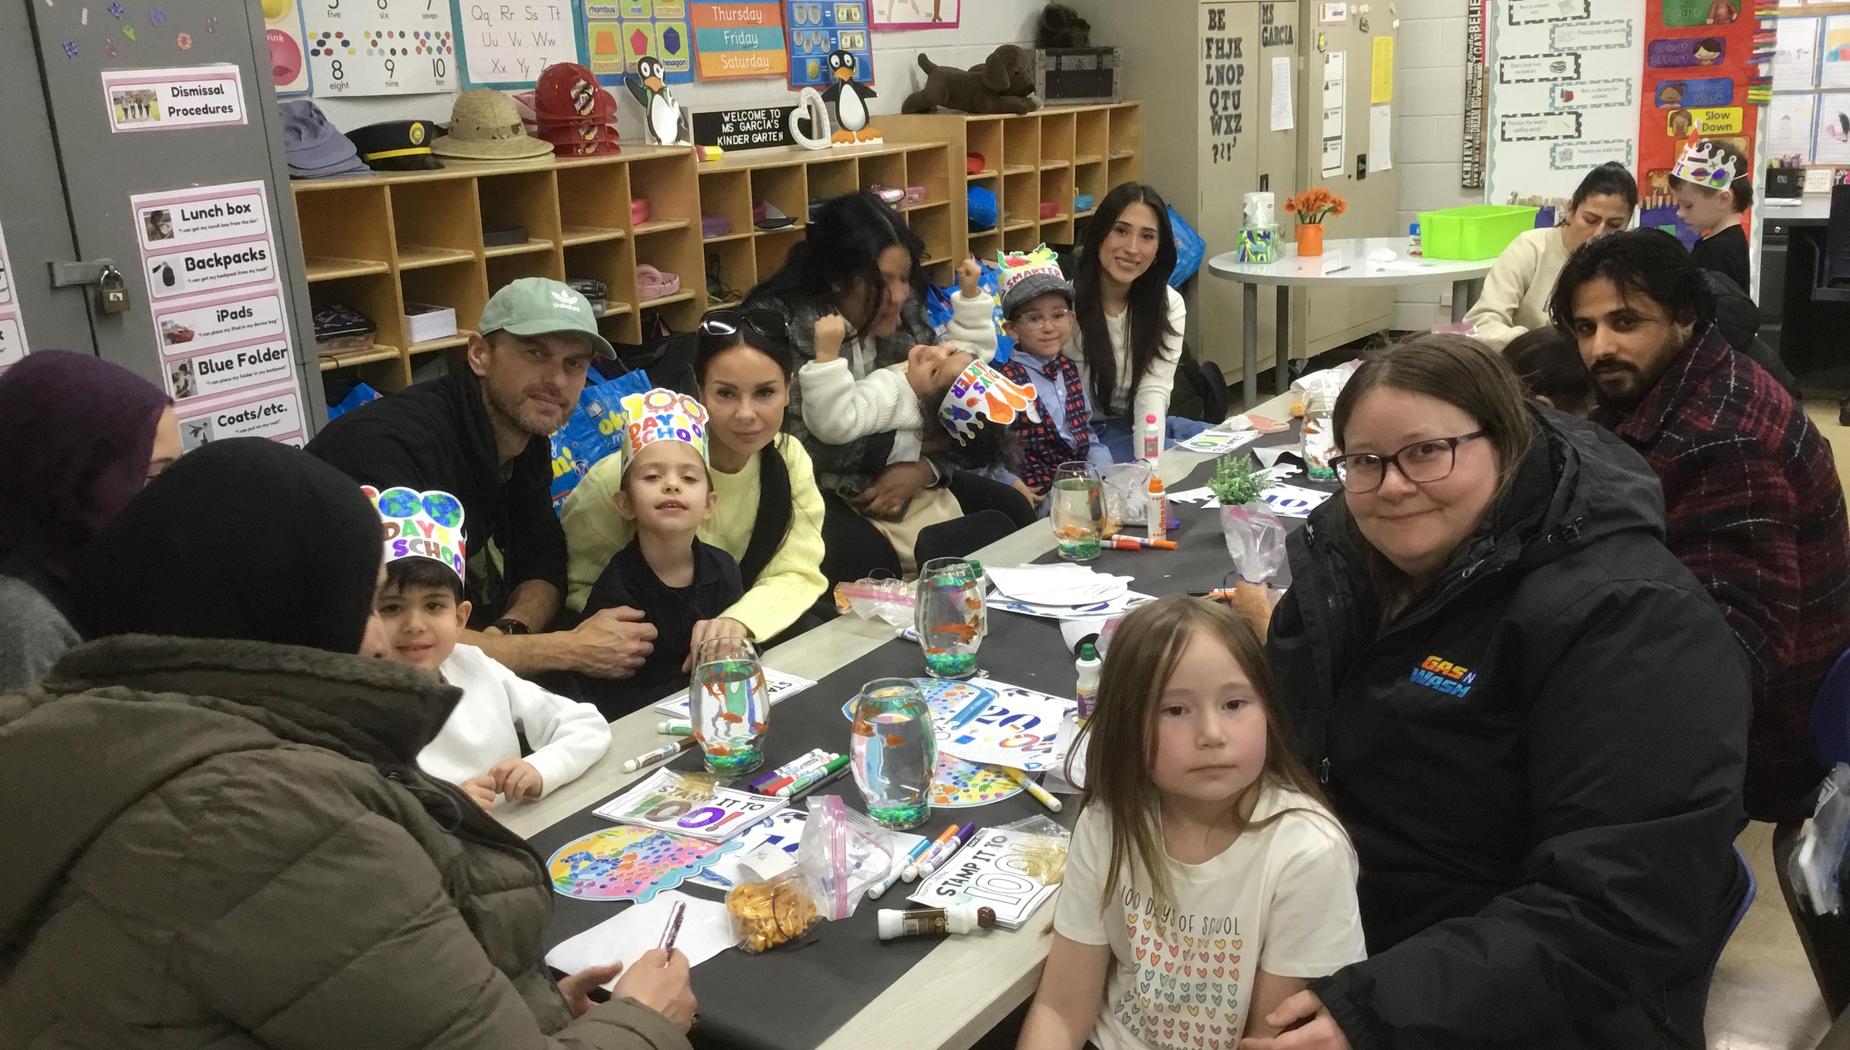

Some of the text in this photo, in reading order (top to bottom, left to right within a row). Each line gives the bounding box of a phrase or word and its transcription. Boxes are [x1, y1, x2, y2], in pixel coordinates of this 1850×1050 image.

[327, 10, 341, 18] five
[471, 5, 561, 27] Qq Rr Ss Tt
[711, 6, 763, 24] Thursday
[1208, 8, 1226, 31] BE
[1262, 3, 1274, 25] MS
[481, 32, 556, 47] Uu Vv Ww
[723, 30, 758, 48] Friday
[1262, 25, 1293, 48] GARCIA
[331, 58, 446, 80] 8 9 10
[491, 59, 507, 74] Xx
[517, 59, 530, 79] Yy
[663, 60, 687, 68] hexagon
[721, 54, 769, 70] Saturday
[170, 84, 224, 97] Dismissal
[329, 82, 350, 92] eight
[385, 80, 399, 88] nine
[168, 104, 234, 117] Procedures
[722, 109, 780, 122] WELCOME TO
[1705, 111, 1731, 120] Slow
[722, 119, 779, 133] MS GARCIA'S
[1702, 123, 1732, 132] Down
[1463, 134, 1472, 186] ACHIEVE
[181, 203, 252, 222] Lunch box
[184, 247, 266, 271] Backpacks
[1007, 267, 1062, 289] SMARTER
[216, 306, 253, 323] iPads
[198, 347, 288, 376] Blue Folder
[217, 403, 287, 427] Coats/etc.
[1422, 655, 1477, 684] GAS N
[1410, 667, 1471, 698] WASH
[624, 795, 745, 832] 100!
[717, 798, 738, 808] IT
[743, 802, 765, 811] TO
[935, 862, 981, 897] STAMP
[972, 849, 996, 863] IT
[984, 835, 1008, 850] TO
[1121, 885, 1141, 910] 100
[1145, 897, 1176, 927] DAYS
[1179, 914, 1195, 933] OF
